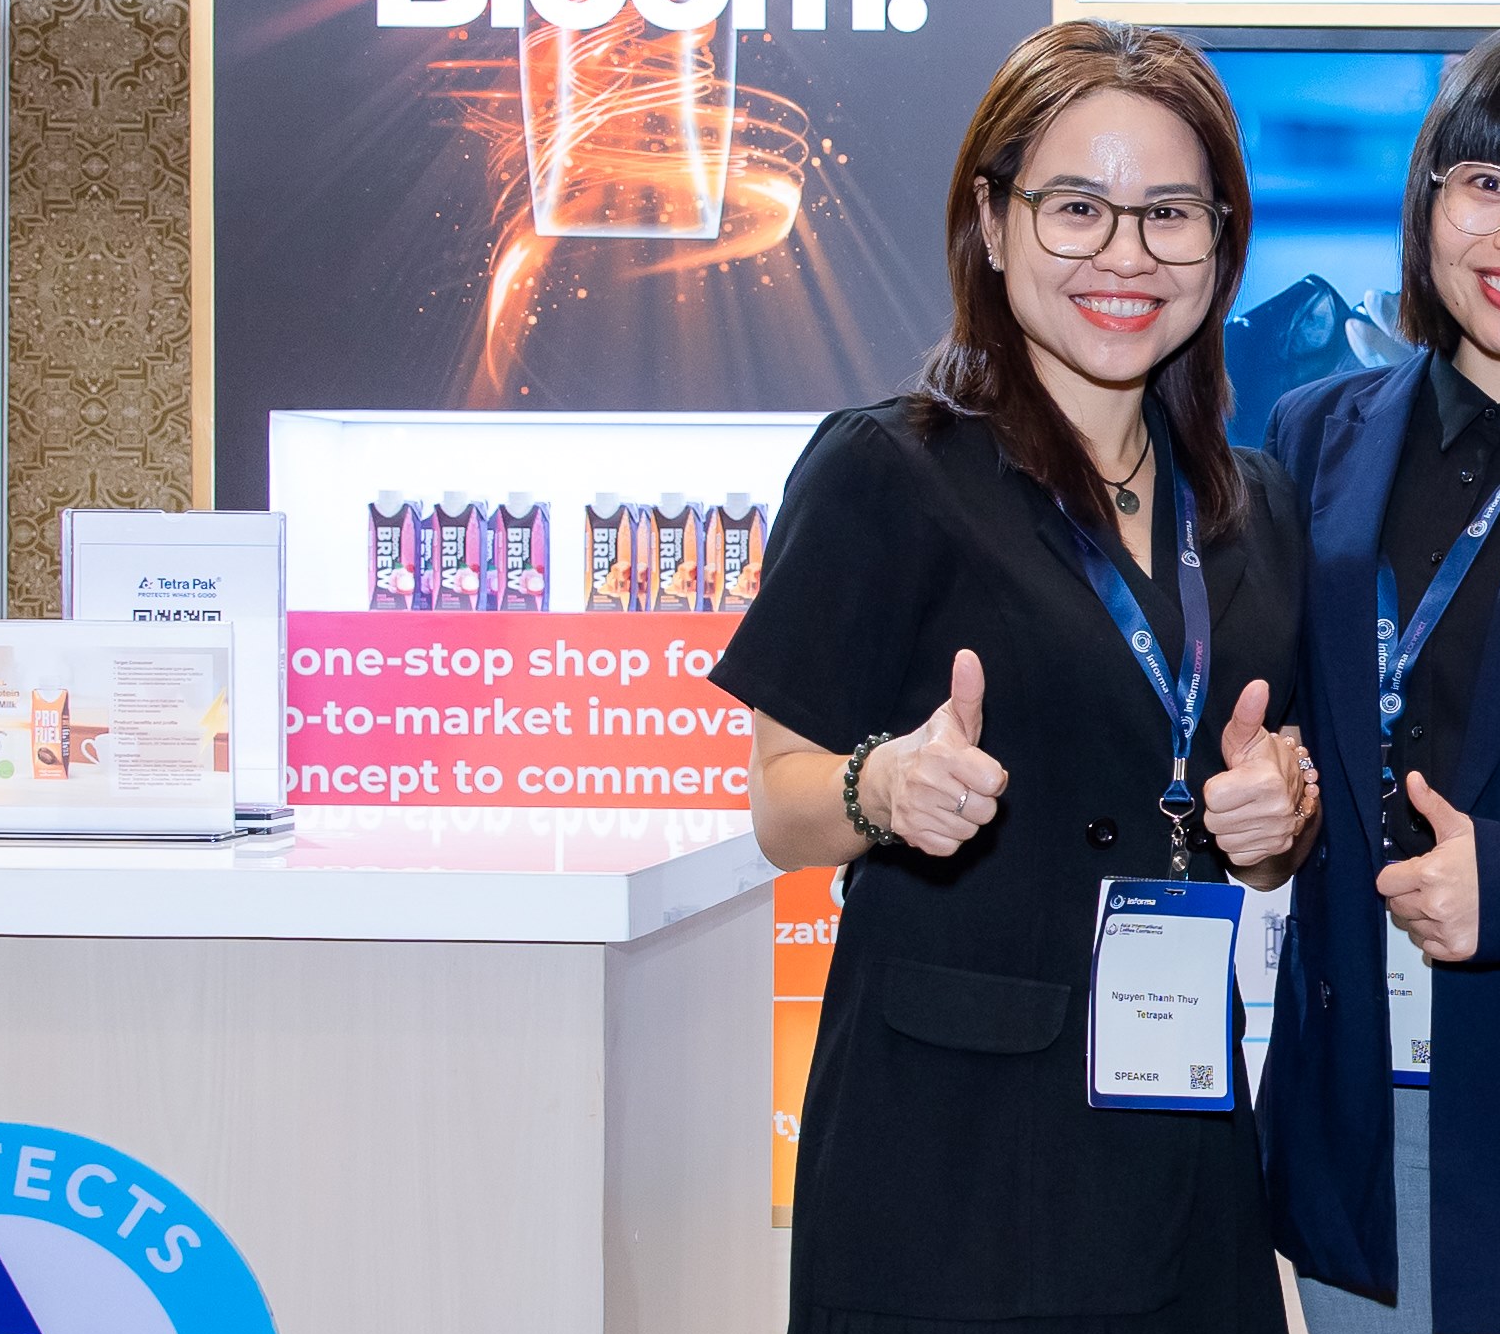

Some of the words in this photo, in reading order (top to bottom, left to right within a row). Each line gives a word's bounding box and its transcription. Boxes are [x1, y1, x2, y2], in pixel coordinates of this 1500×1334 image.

[376, 527, 392, 589] BREW
[442, 527, 458, 589] BREW
[507, 528, 523, 590] BREW
[593, 528, 609, 589] BREW
[660, 528, 676, 589] BREW
[725, 529, 741, 590] BREW
[157, 577, 190, 589] Tetra
[291, 641, 513, 685] one-stop
[528, 640, 651, 685] shop
[1145, 653, 1169, 694] informa
[1391, 653, 1409, 691] informa
[1184, 673, 1202, 713] informa
[35, 710, 60, 727] PRO
[35, 727, 61, 744] FUEL
[588, 697, 753, 736] innova
[453, 760, 503, 794] to
[517, 765, 749, 795] commerc
[1126, 897, 1157, 906] informa
[1111, 991, 1145, 1003] Nguyen
[1147, 992, 1174, 1003] Thanh
[1177, 994, 1199, 1006] Thuy
[1136, 1009, 1173, 1021] Tetrapak
[1114, 1071, 1159, 1081] SPEAKER
